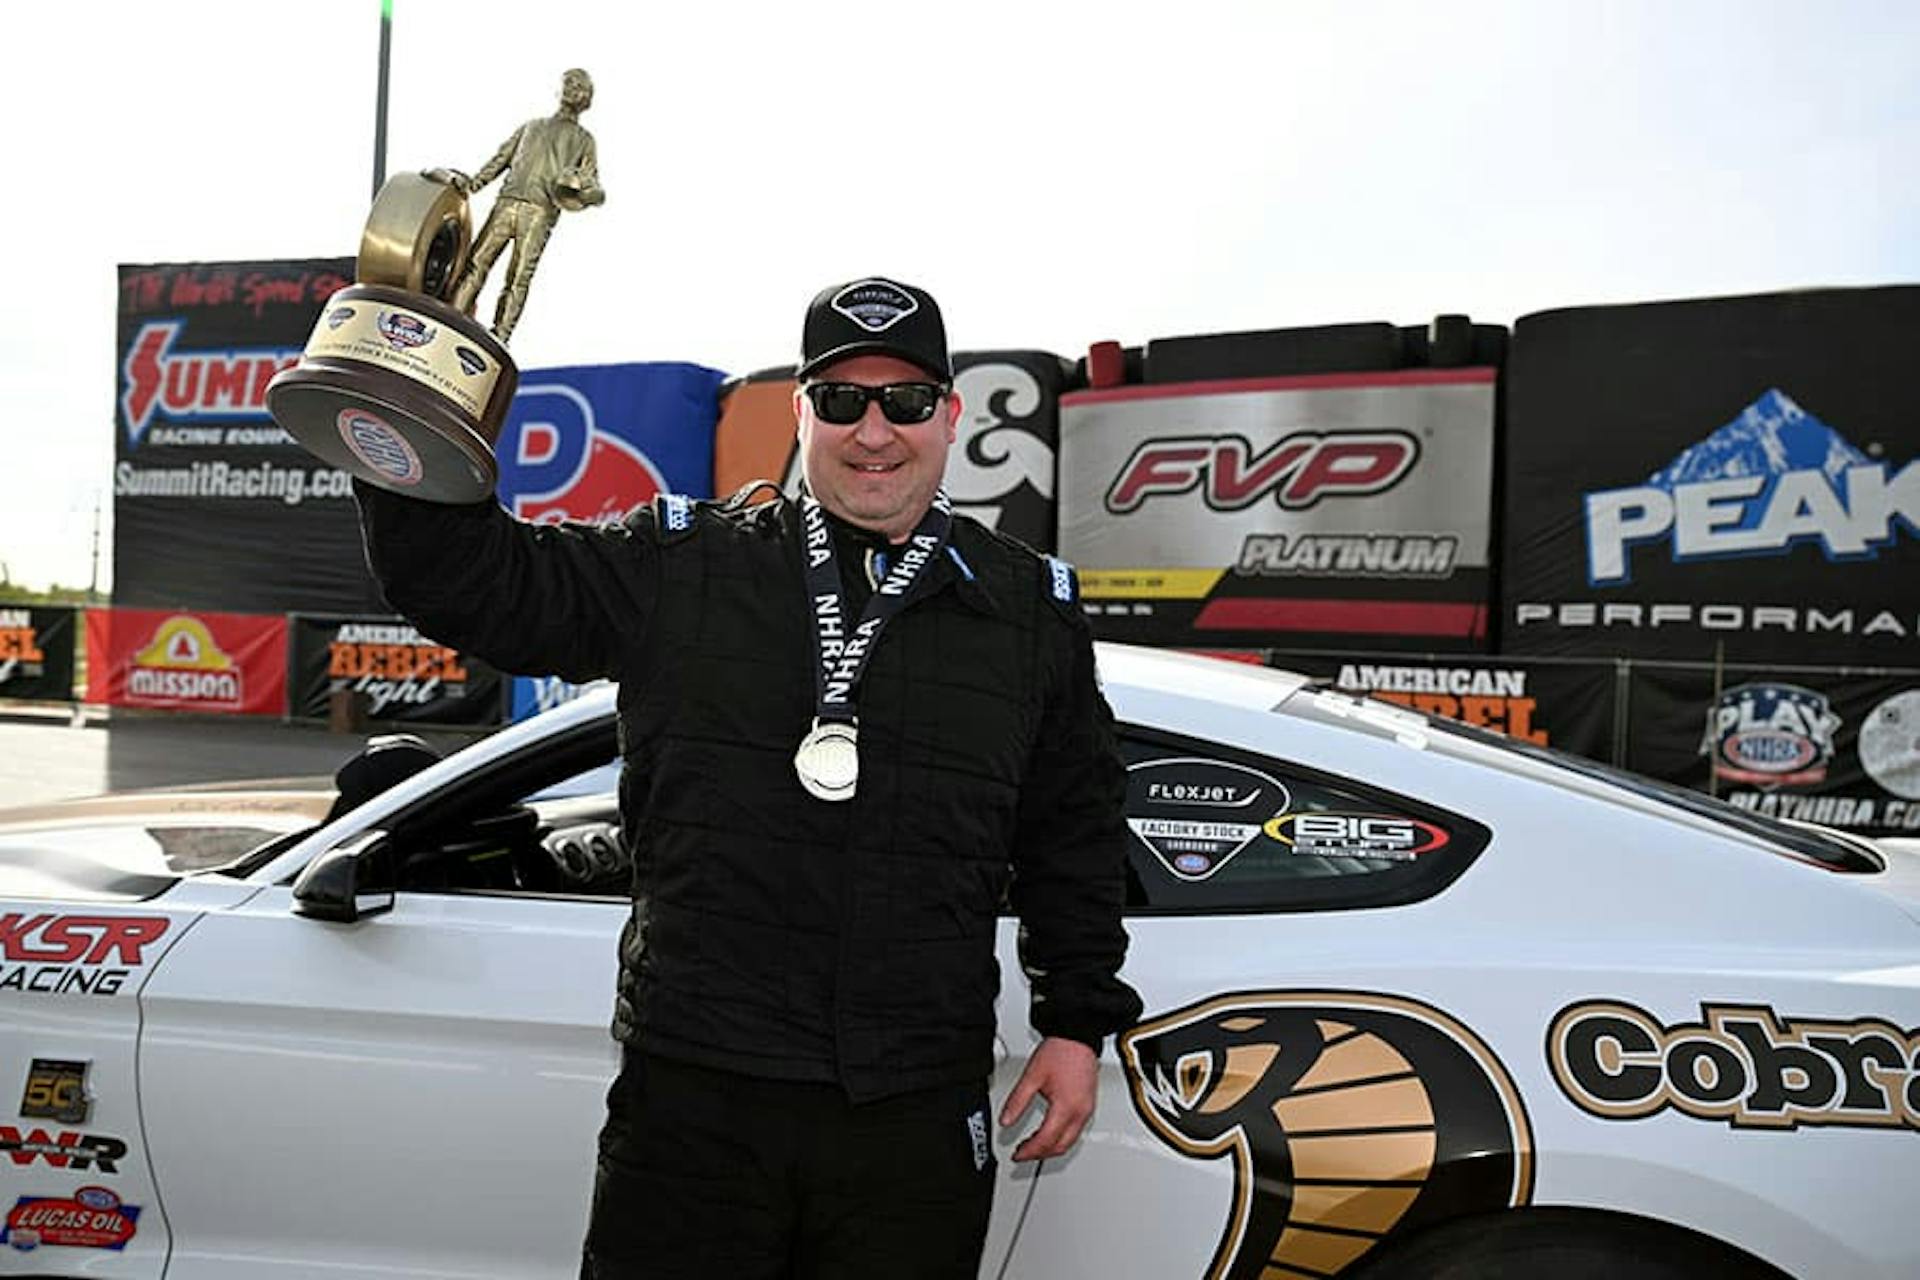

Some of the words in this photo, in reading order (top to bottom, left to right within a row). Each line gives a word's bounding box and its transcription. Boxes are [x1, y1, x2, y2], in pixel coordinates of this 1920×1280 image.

[122, 323, 298, 434] SUMM
[116, 461, 356, 504] SummitRacing.co
[1106, 429, 1422, 514] FVP
[1586, 457, 1920, 583] PEAK
[880, 534, 939, 595] NHRA
[1240, 535, 1458, 578] PLATINUM
[336, 623, 421, 644] AMERIC
[815, 593, 846, 683] NHR
[1517, 604, 1920, 637] PERFORMA
[329, 643, 468, 680] REBEL
[1337, 664, 1527, 697] AMERICAN
[1709, 699, 1841, 748] PLAY
[1294, 814, 1414, 842] BIG
[0, 913, 171, 965] KSR
[0, 966, 129, 995] ACING
[16, 1207, 92, 1230] LUCAS
[91, 1212, 124, 1234] OIL
